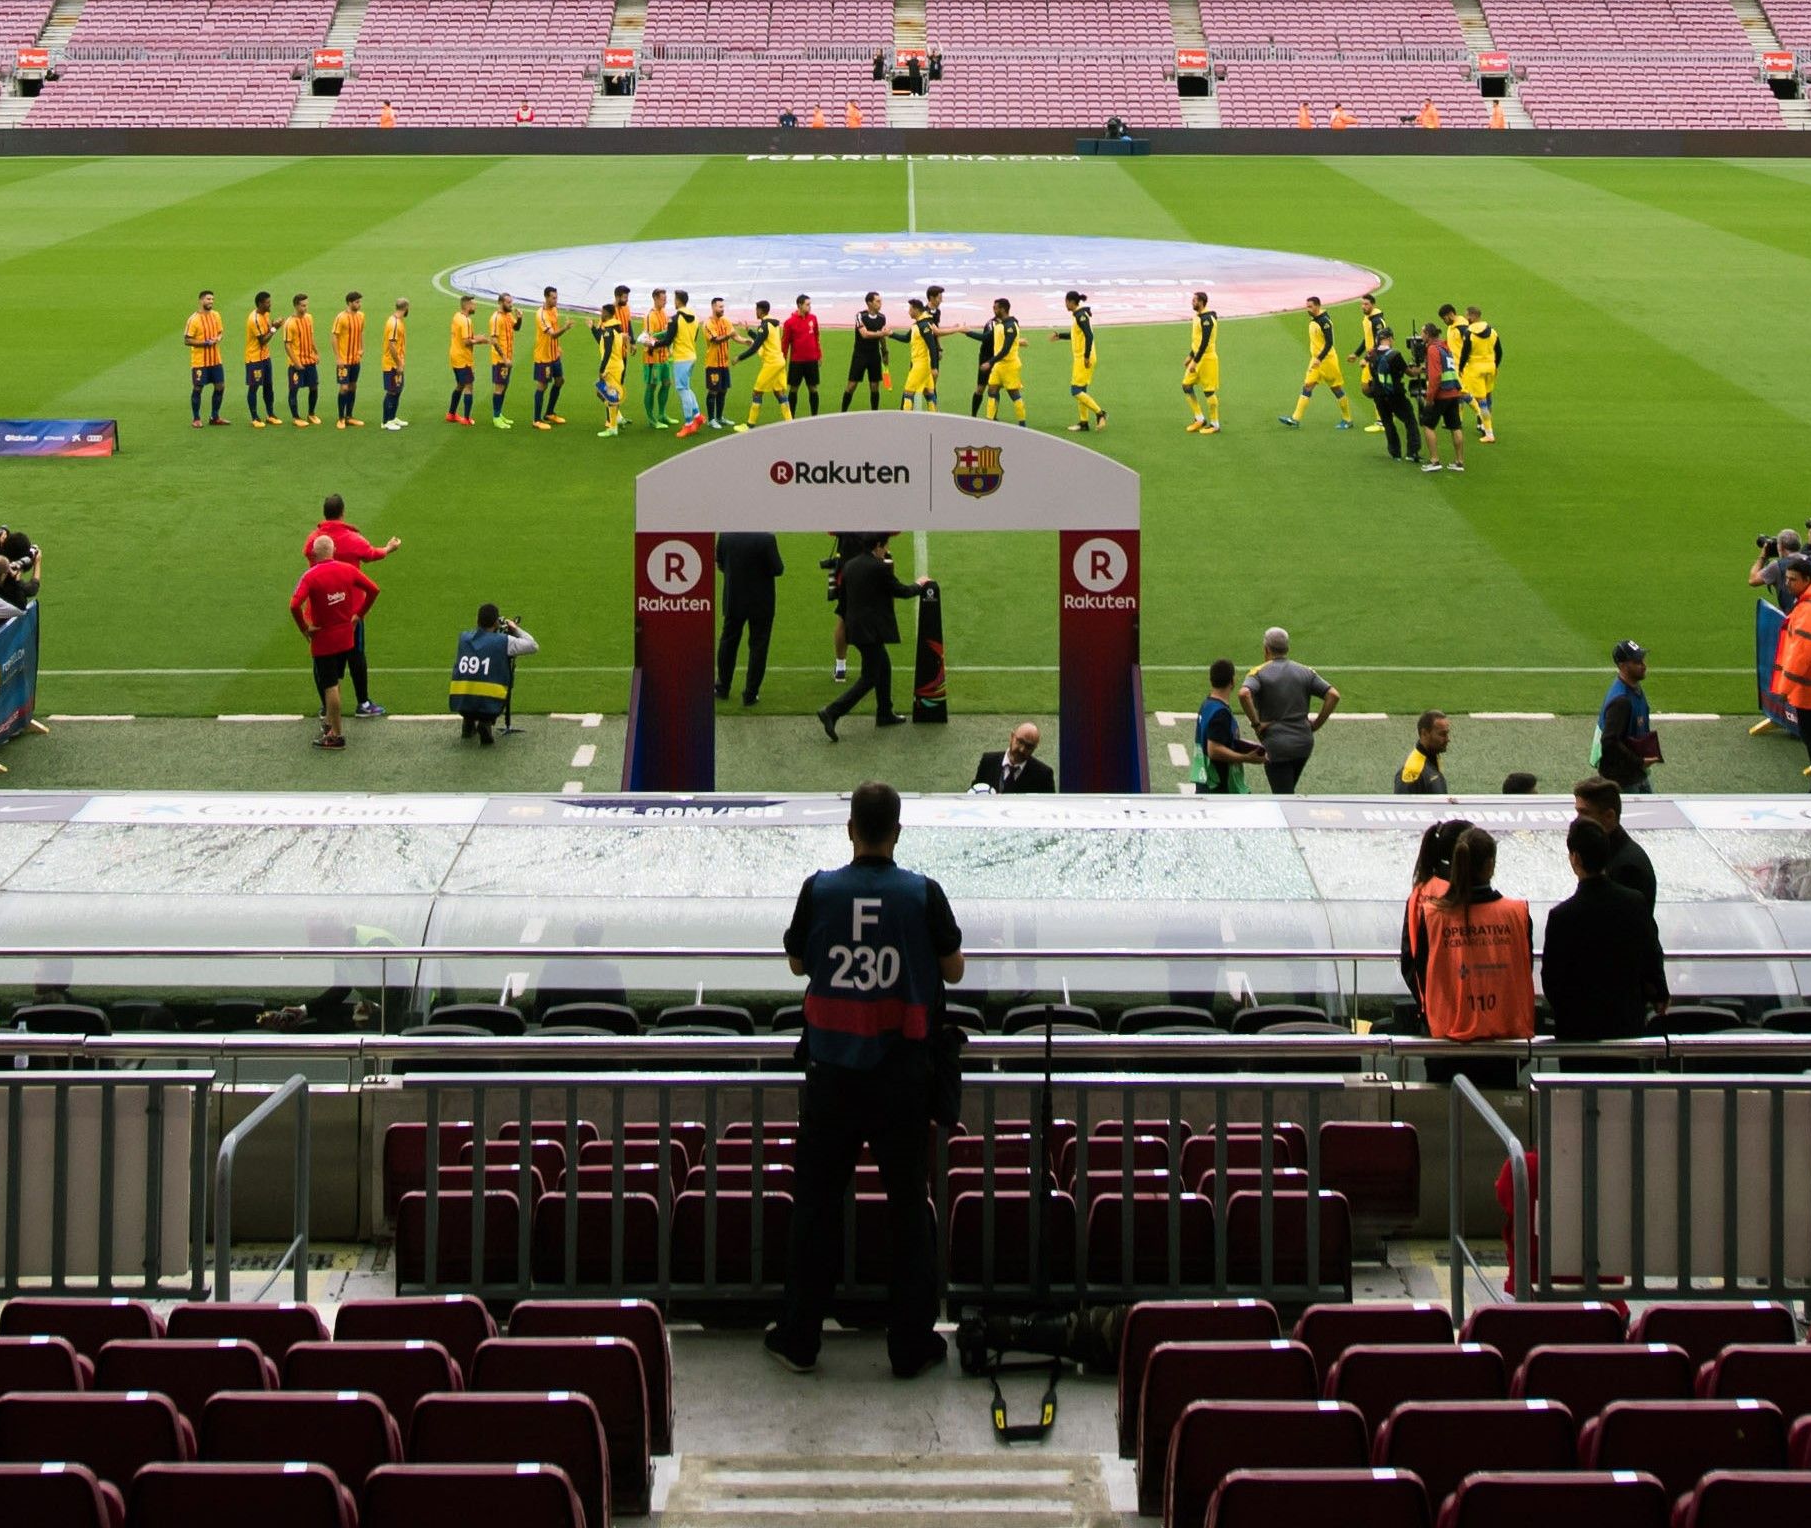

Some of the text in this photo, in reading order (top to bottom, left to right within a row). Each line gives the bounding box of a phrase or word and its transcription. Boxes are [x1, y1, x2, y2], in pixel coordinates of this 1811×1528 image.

[795, 460, 910, 485] Rakuten
[638, 596, 711, 613] Rakuten
[1064, 594, 1137, 610] Rakuten
[458, 655, 491, 675] 691
[198, 802, 416, 818] CaixaBank
[561, 802, 784, 819] NIKE.COM/FCB
[852, 897, 882, 942] F
[828, 944, 902, 992] 230
[1467, 994, 1496, 1011] 110
